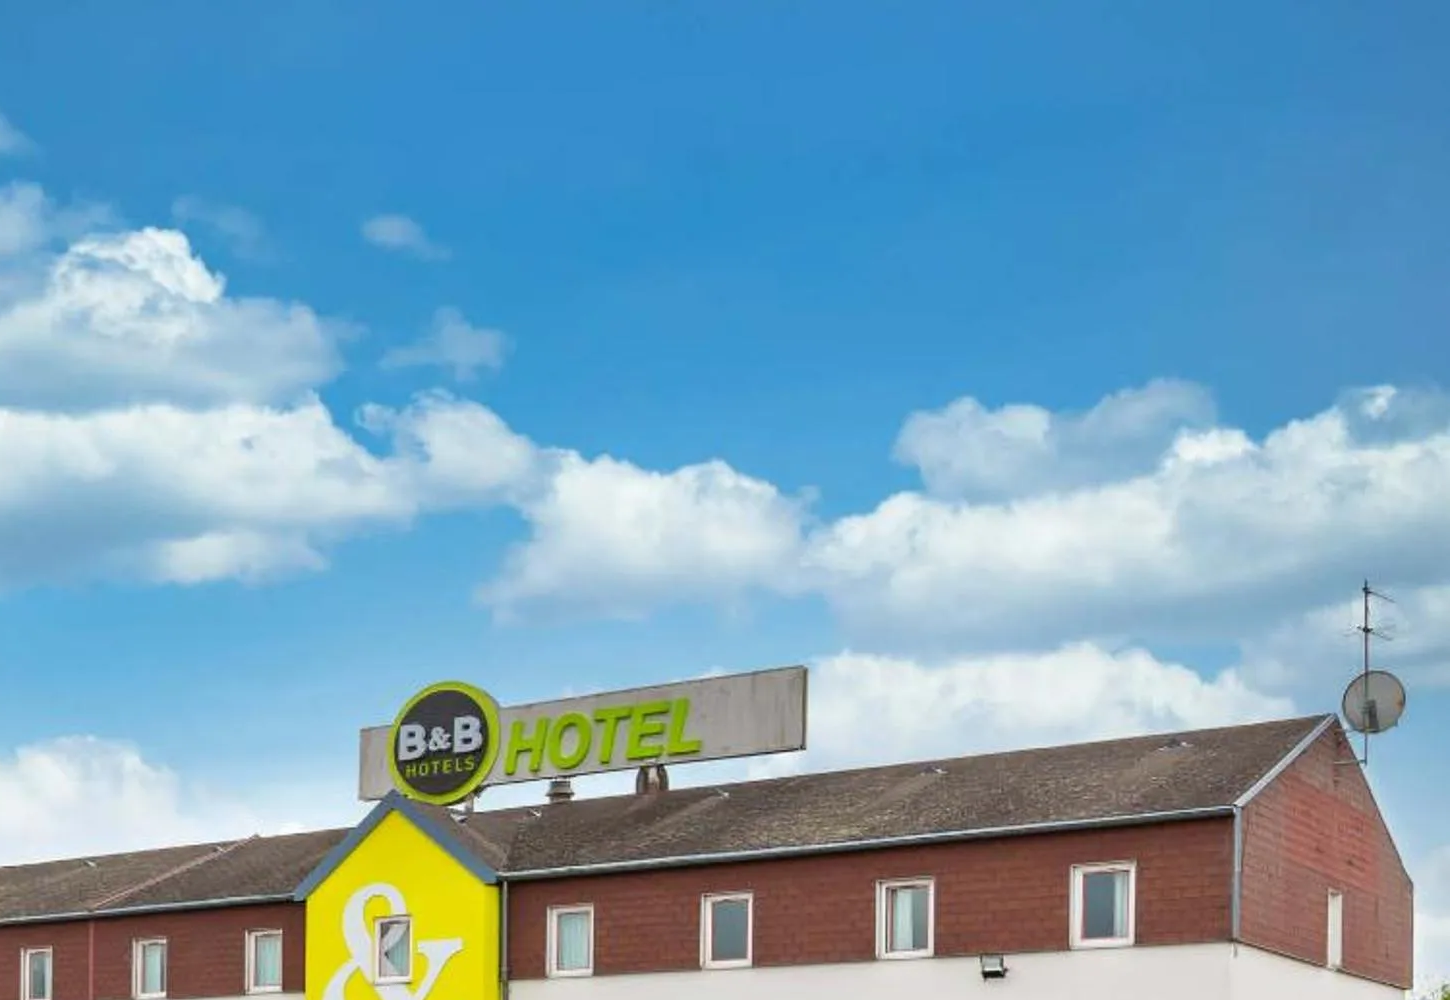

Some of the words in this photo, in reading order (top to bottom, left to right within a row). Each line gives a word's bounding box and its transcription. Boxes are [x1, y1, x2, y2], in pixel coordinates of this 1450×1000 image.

[397, 715, 483, 761] B&B
[503, 697, 703, 776] HOTEL
[404, 757, 475, 778] HOTELS
